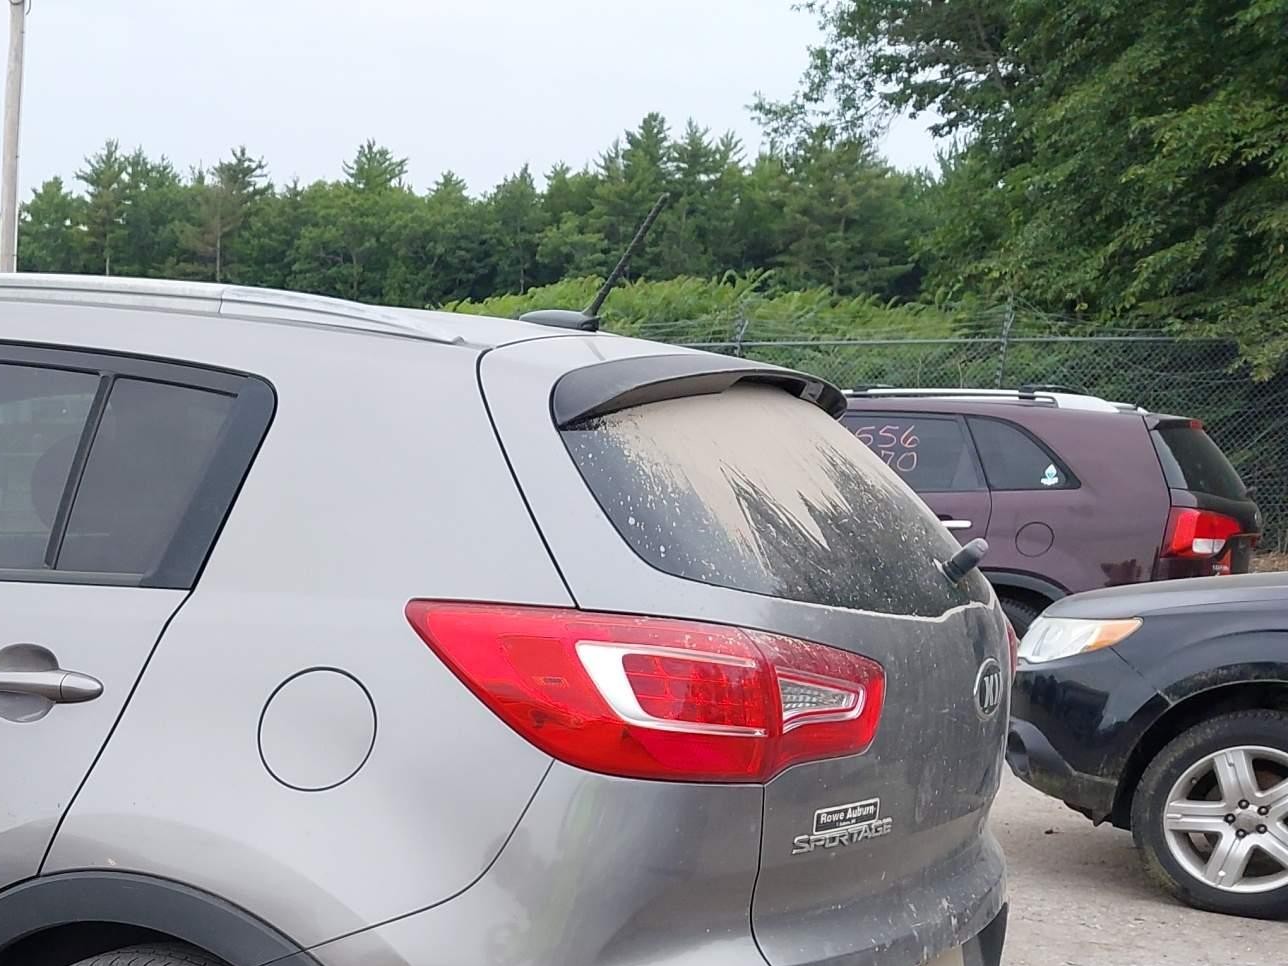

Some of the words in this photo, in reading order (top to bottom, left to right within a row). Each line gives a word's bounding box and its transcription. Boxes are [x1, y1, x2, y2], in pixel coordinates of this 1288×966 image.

[854, 424, 920, 448] 556
[880, 449, 917, 471] 70
[820, 811, 845, 825] Rowe
[846, 804, 875, 820] Auburn
[792, 817, 893, 855] SPORTAGE
